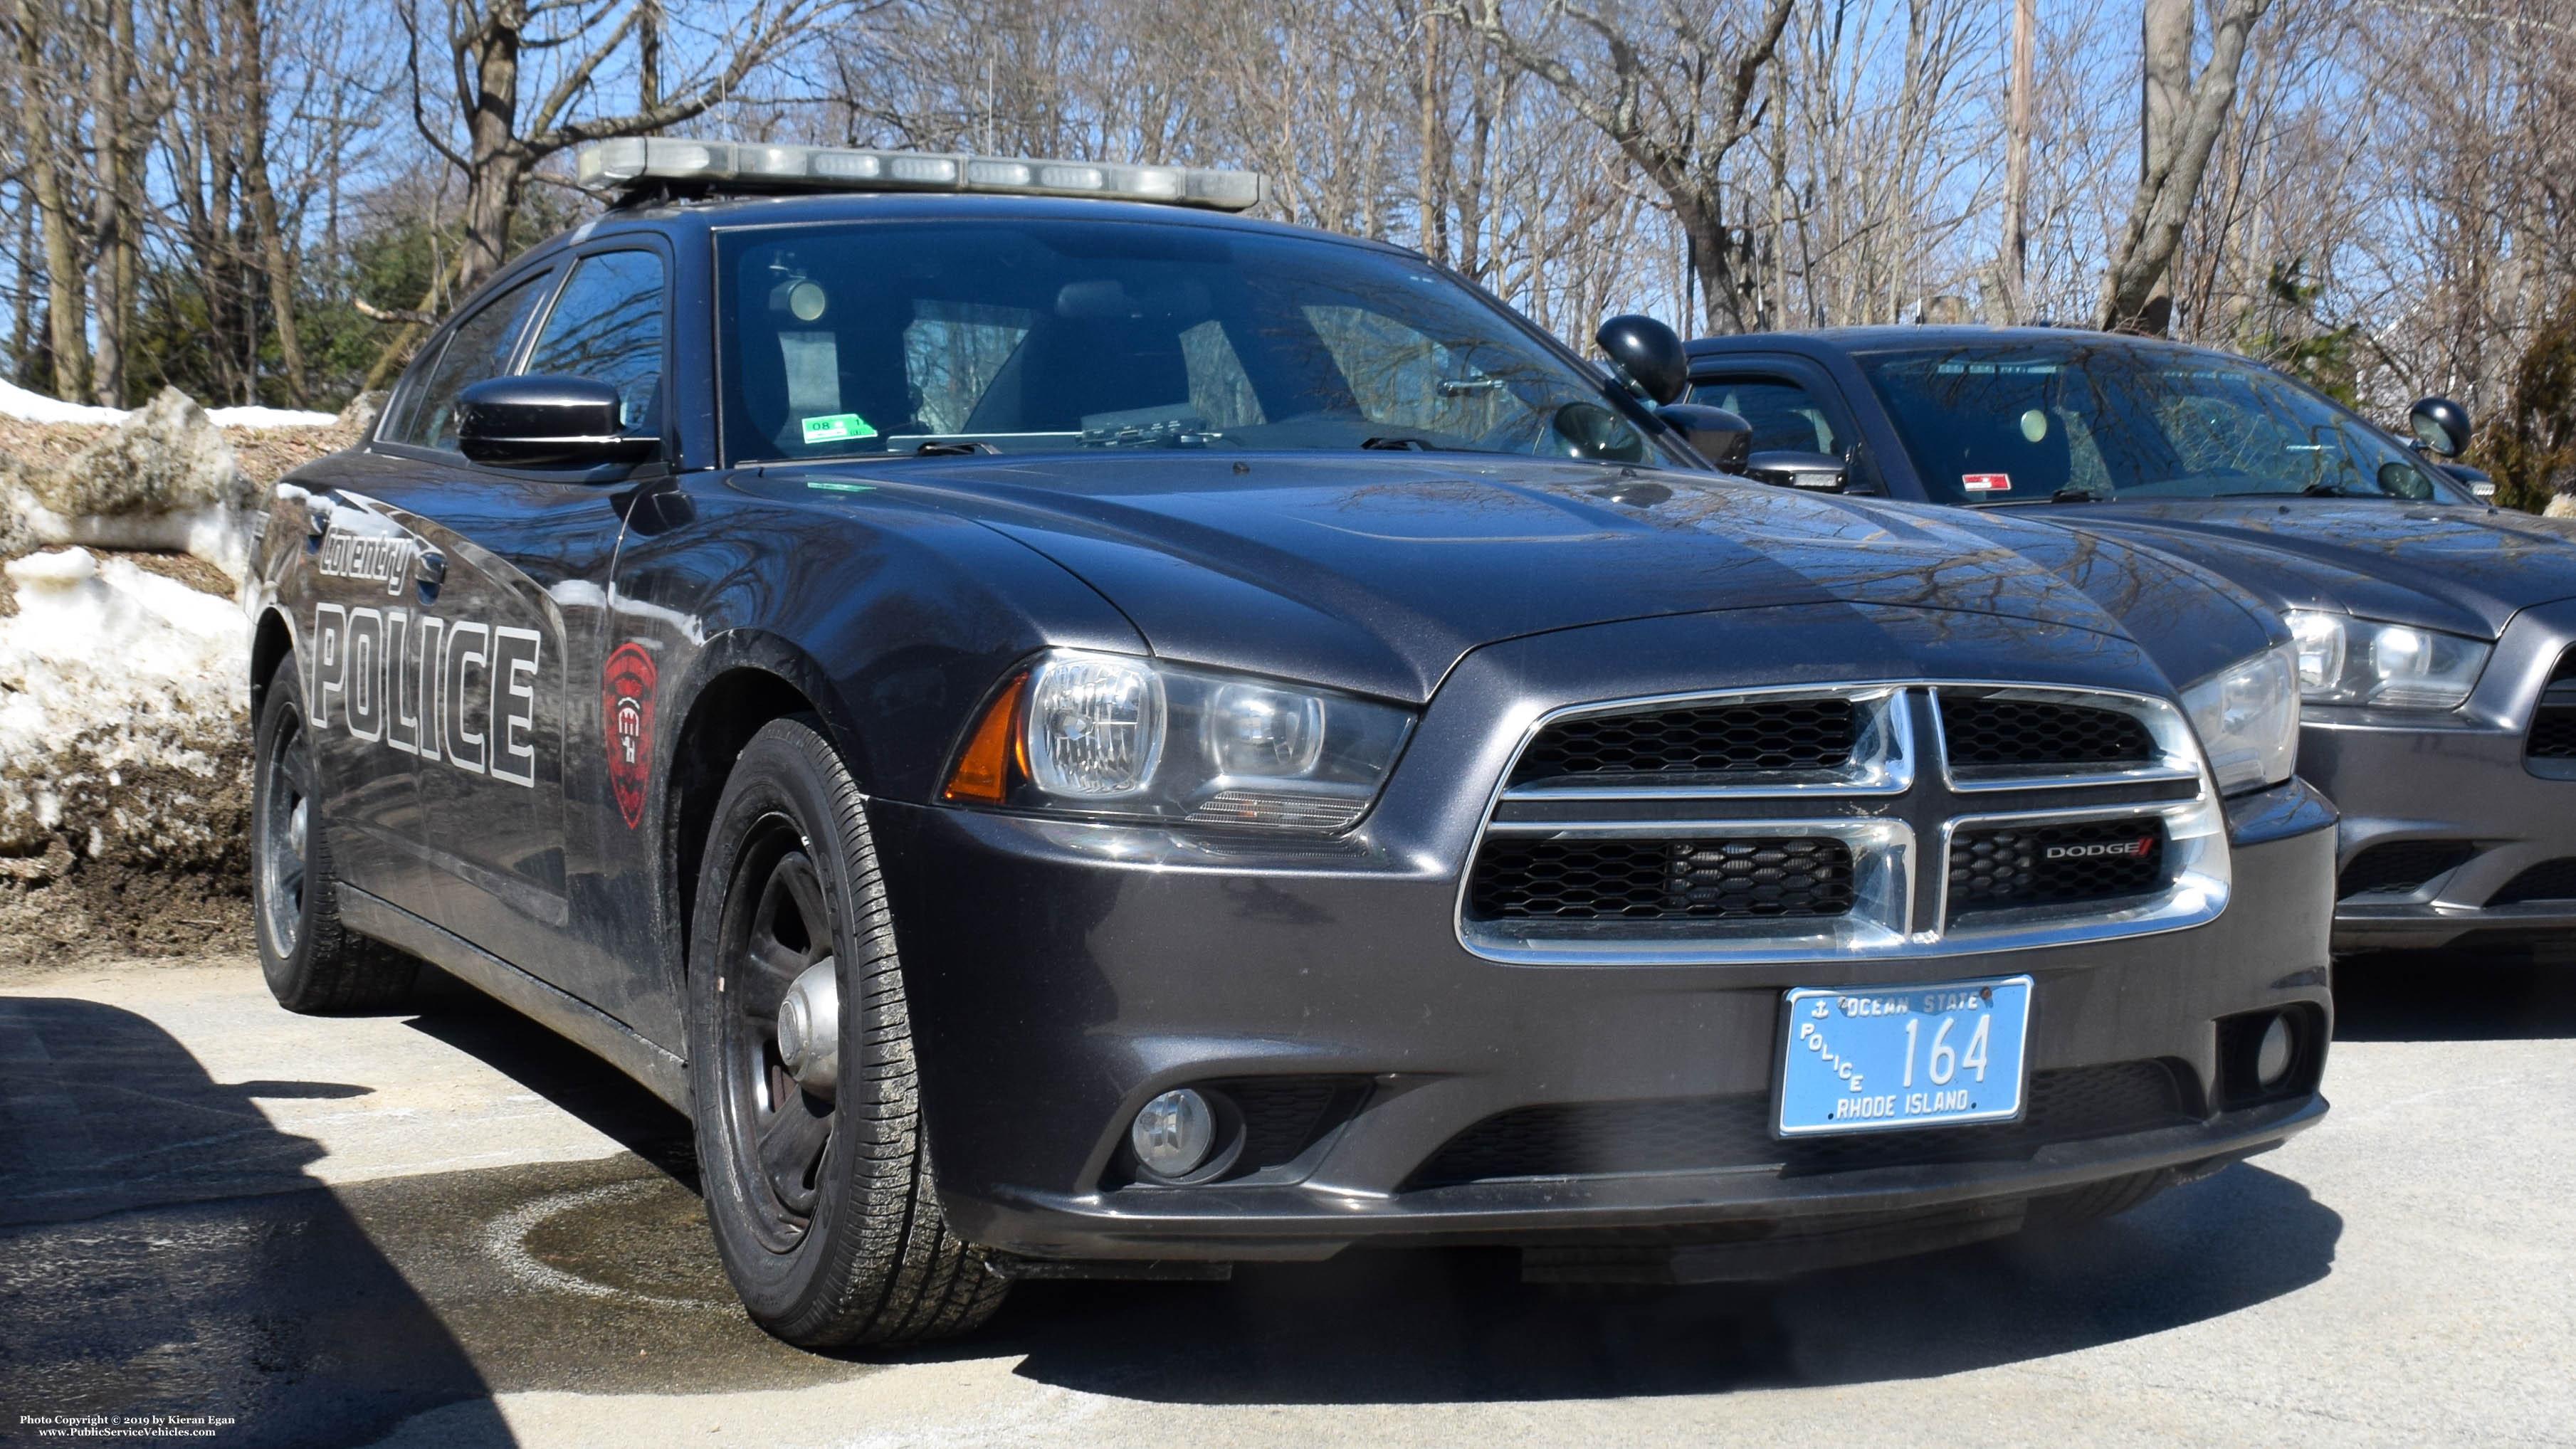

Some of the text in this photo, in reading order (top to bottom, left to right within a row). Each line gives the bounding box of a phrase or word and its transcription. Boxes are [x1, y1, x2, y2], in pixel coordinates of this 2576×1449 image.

[813, 422, 830, 431] 08
[320, 523, 413, 596] Coventry
[310, 602, 541, 788] POLICE
[2046, 842, 2140, 858] DODGE
[1846, 994, 1978, 1018] OCEAN STATE
[1799, 1023, 1864, 1092] POLICE
[1903, 1014, 1991, 1087] 164
[1836, 1090, 1968, 1119] RHODE ISLAND
